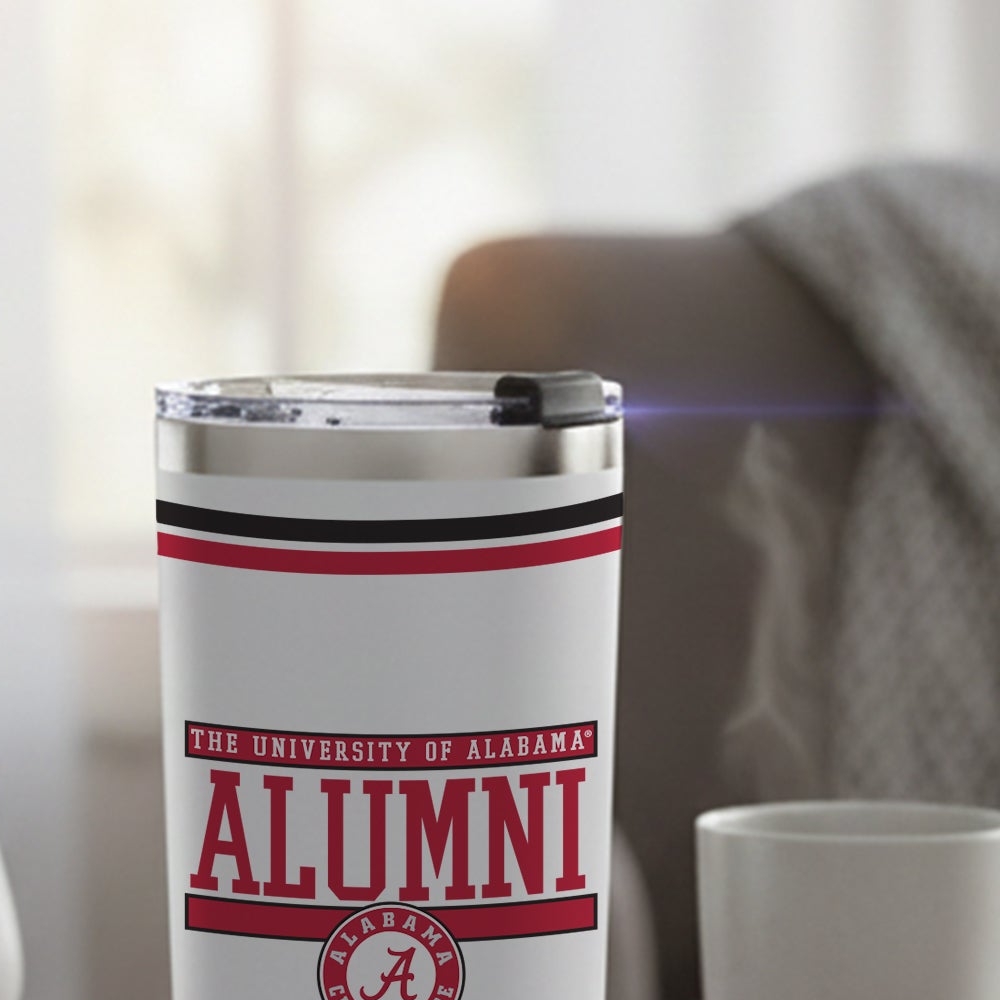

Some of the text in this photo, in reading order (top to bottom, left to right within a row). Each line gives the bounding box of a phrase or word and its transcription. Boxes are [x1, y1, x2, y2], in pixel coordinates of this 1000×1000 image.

[190, 728, 238, 755] THE
[253, 737, 411, 763] UNIVERSITY
[425, 740, 453, 762] OF
[190, 767, 586, 901] ALUMNI
[329, 911, 450, 966] ALABAMA
